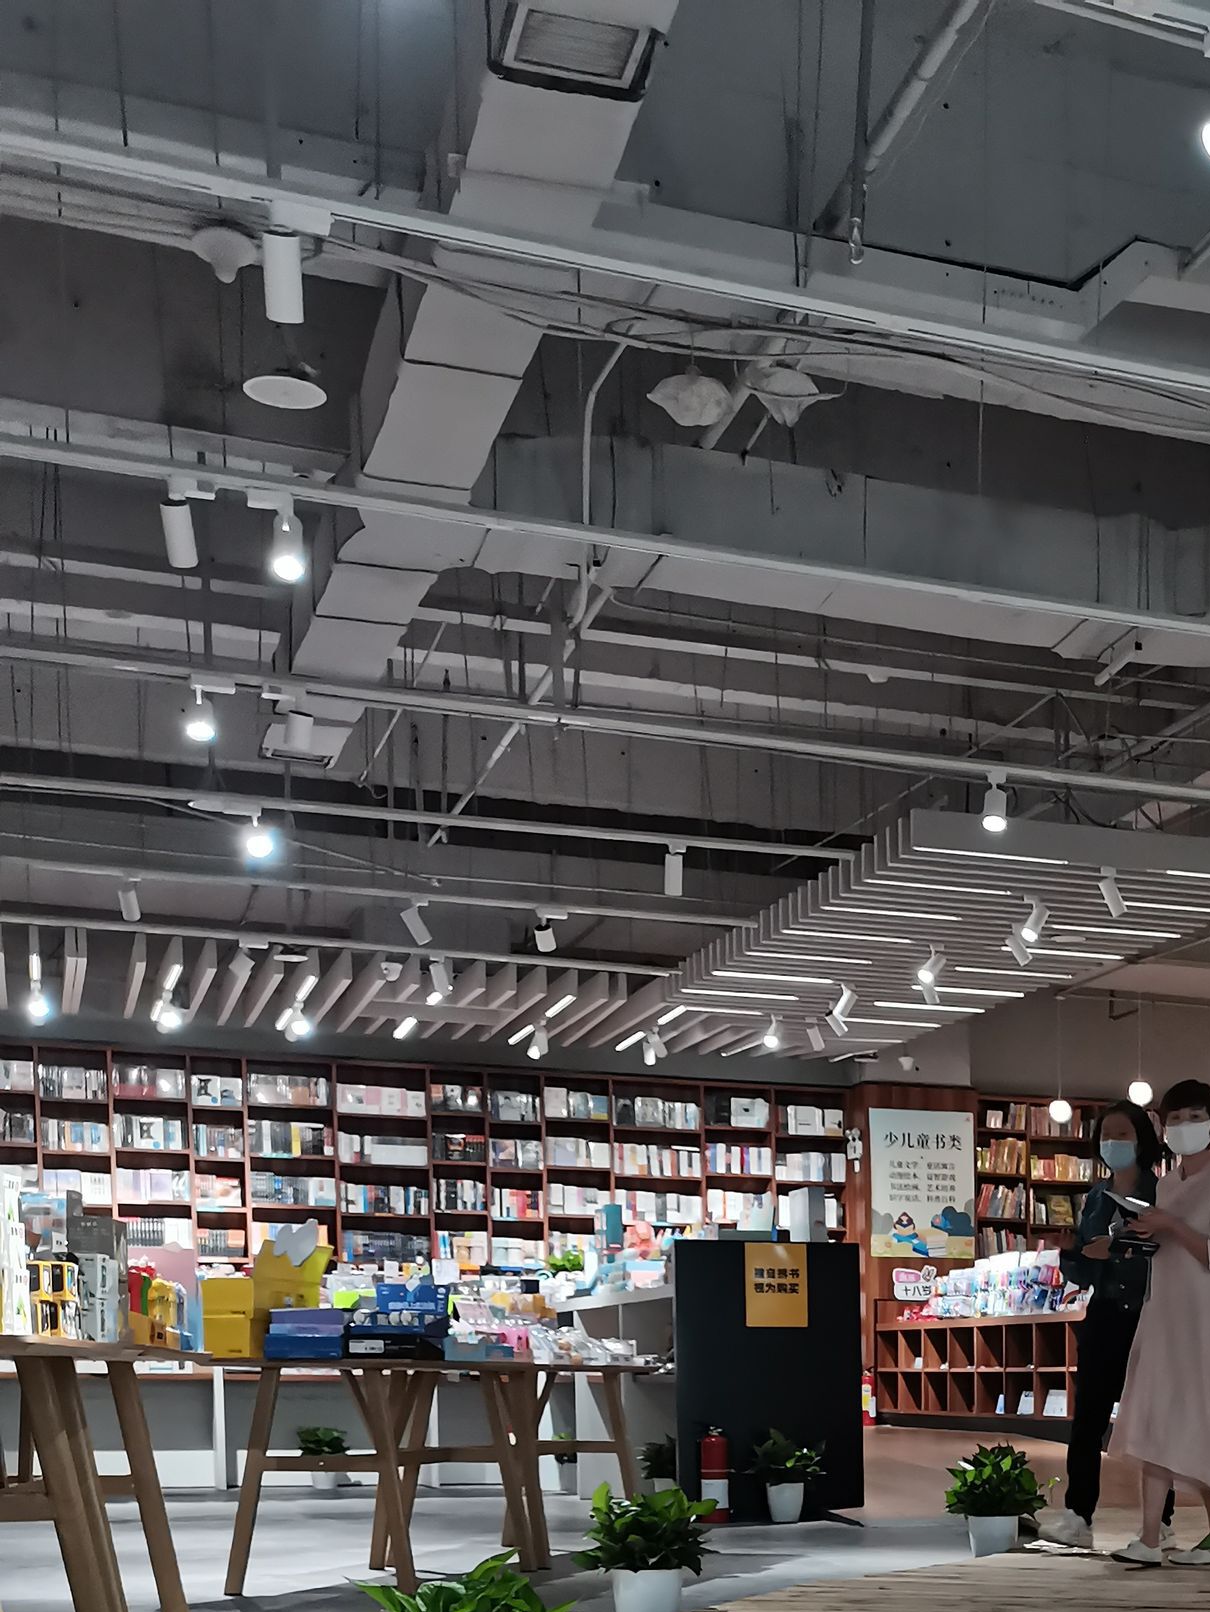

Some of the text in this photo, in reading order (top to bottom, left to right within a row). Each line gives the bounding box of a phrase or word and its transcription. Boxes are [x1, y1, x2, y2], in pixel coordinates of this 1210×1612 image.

[884, 1131, 962, 1151] 少儿童书类
